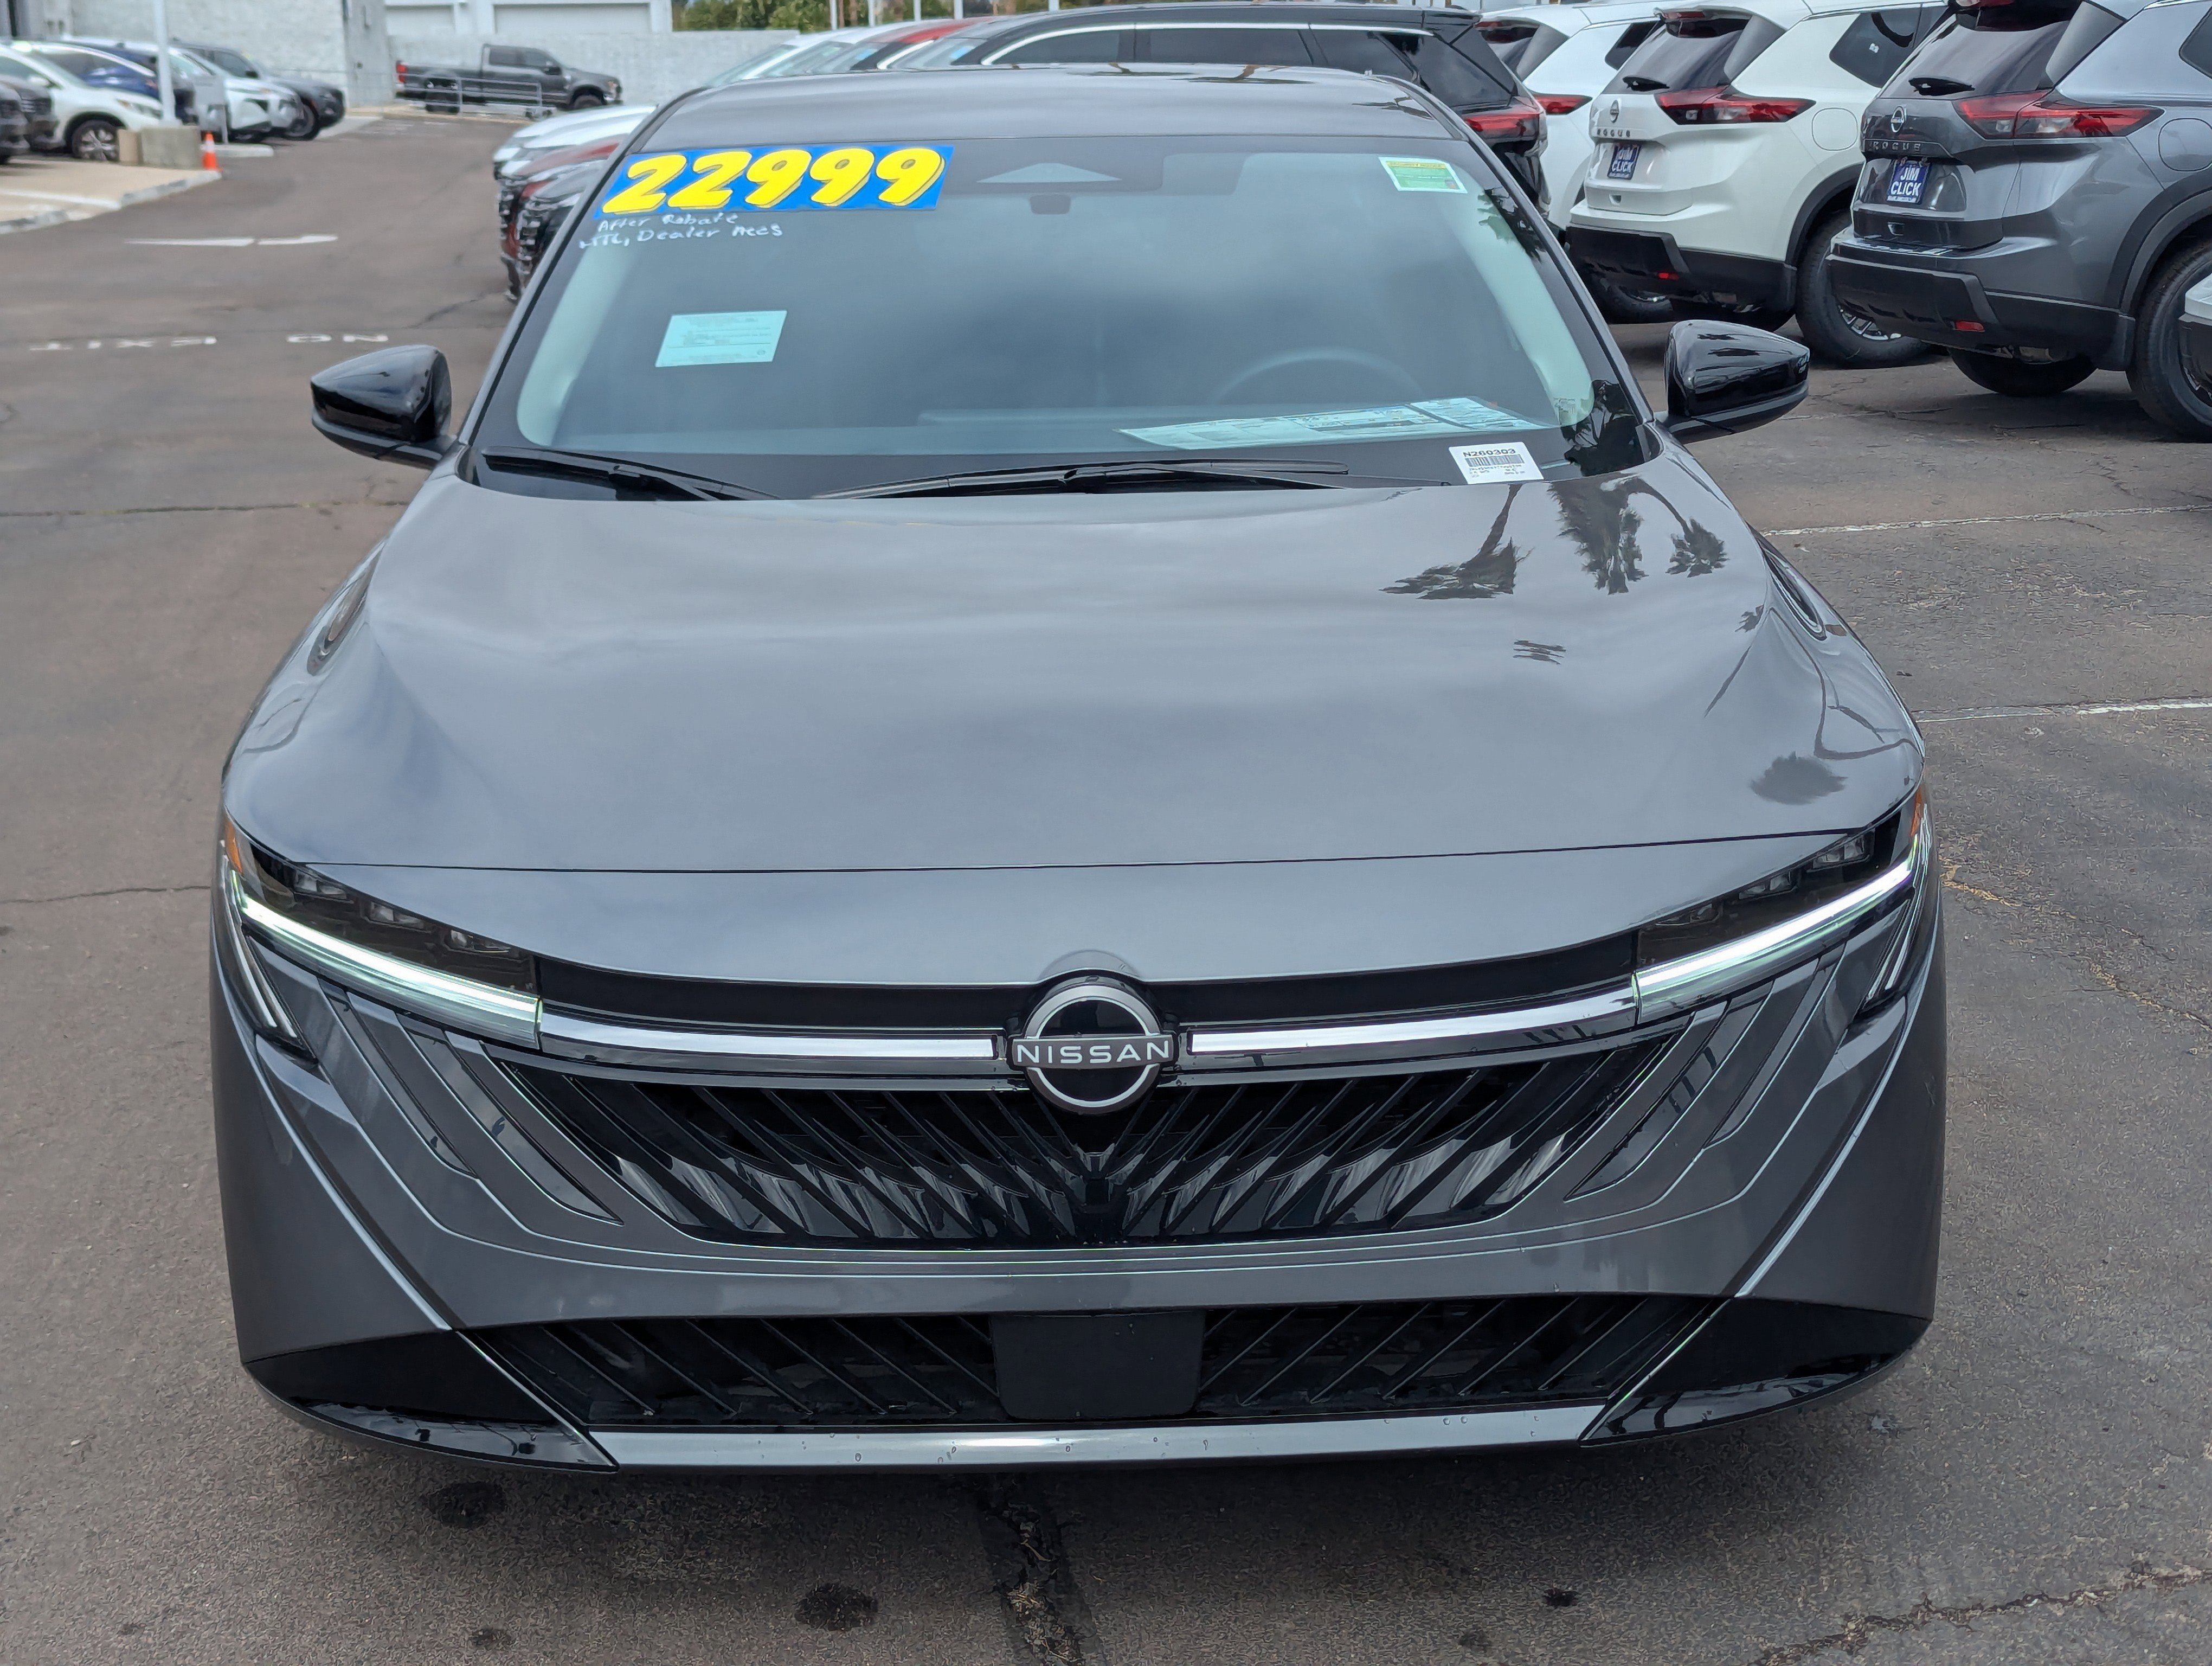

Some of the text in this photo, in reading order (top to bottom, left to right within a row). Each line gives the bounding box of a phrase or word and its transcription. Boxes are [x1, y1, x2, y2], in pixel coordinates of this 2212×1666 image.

[1873, 142, 1921, 151] ROGUE
[1612, 161, 1634, 172] CLICK
[1900, 166, 1920, 181] JIM
[602, 148, 945, 214] 22999
[1891, 181, 1921, 196] CLICK
[597, 212, 738, 231] After Rebate
[637, 226, 721, 241] Dealer
[1017, 1040, 1169, 1063] NISSAN
